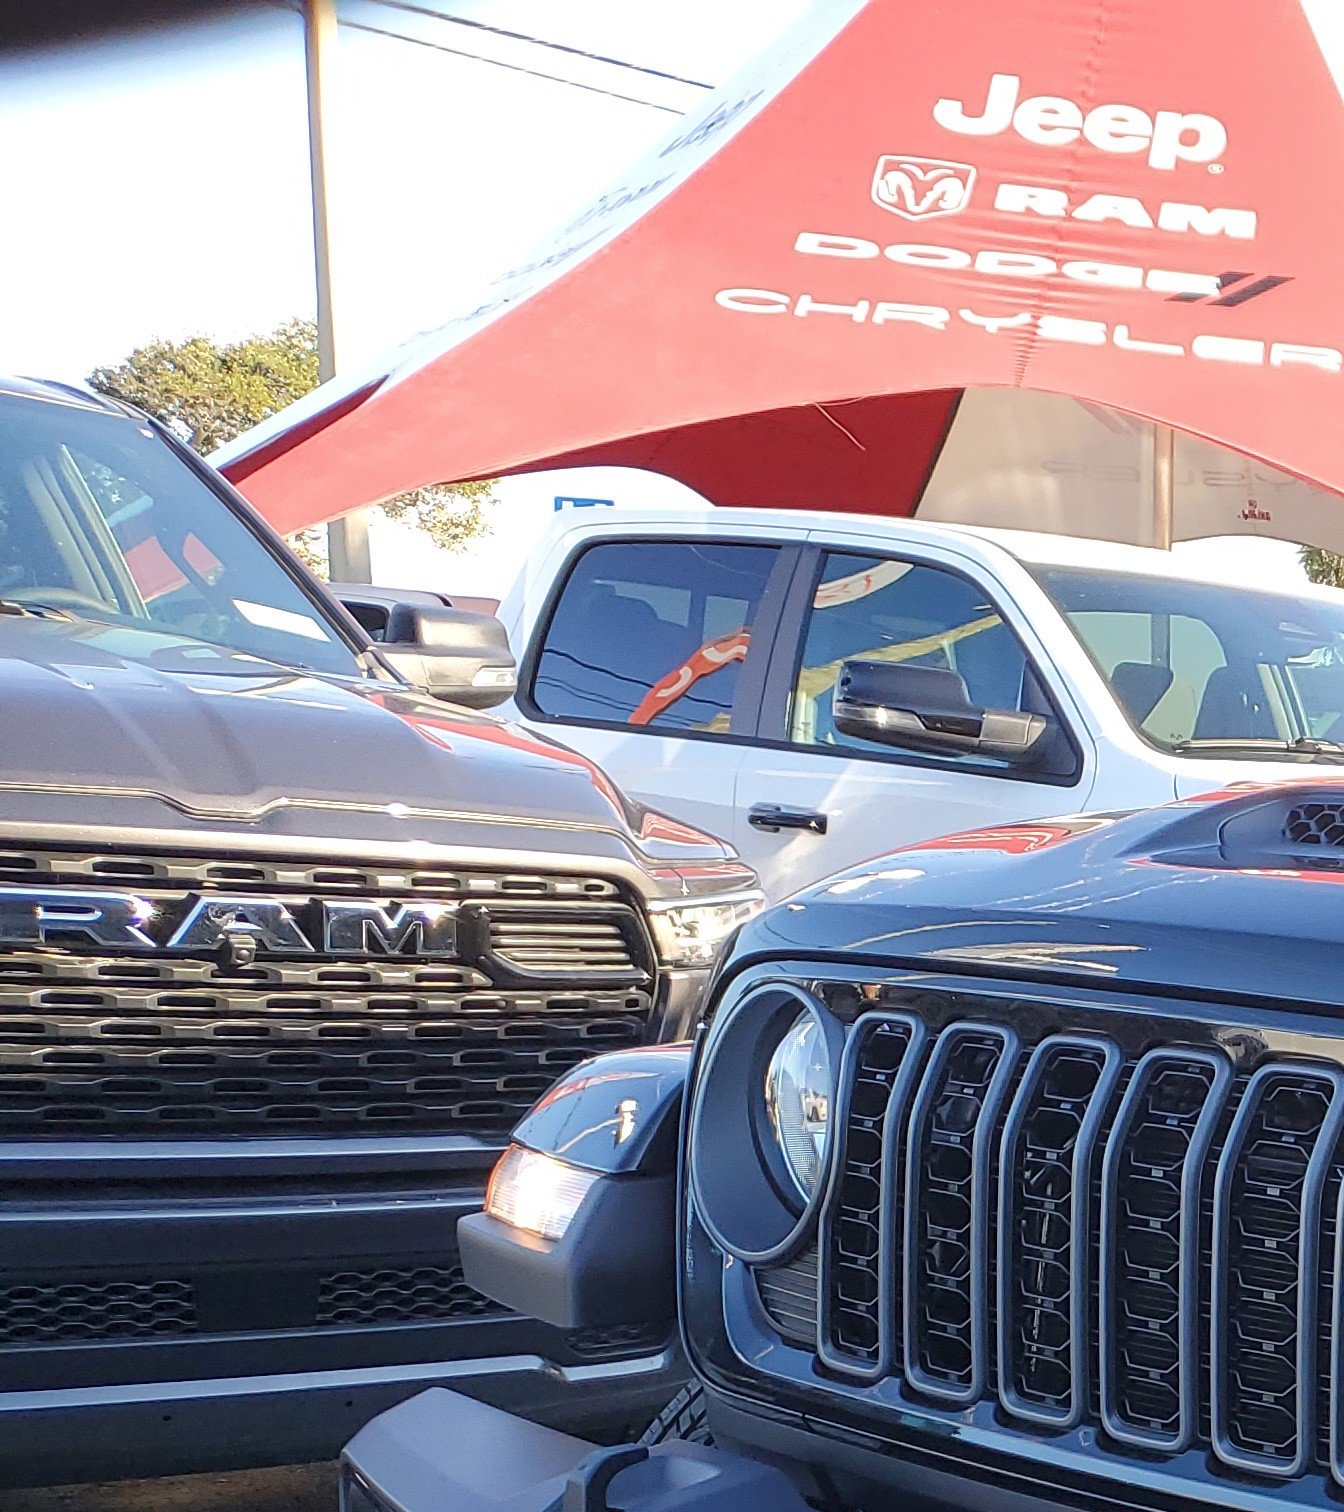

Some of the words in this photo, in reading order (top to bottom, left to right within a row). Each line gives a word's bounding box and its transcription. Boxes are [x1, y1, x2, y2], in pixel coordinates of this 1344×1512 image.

[934, 73, 1226, 170] Jeep
[994, 183, 1257, 239] RAM
[794, 232, 1222, 296] DODGE
[714, 287, 1343, 374] CHRYSLER
[0, 887, 459, 958] RAM
